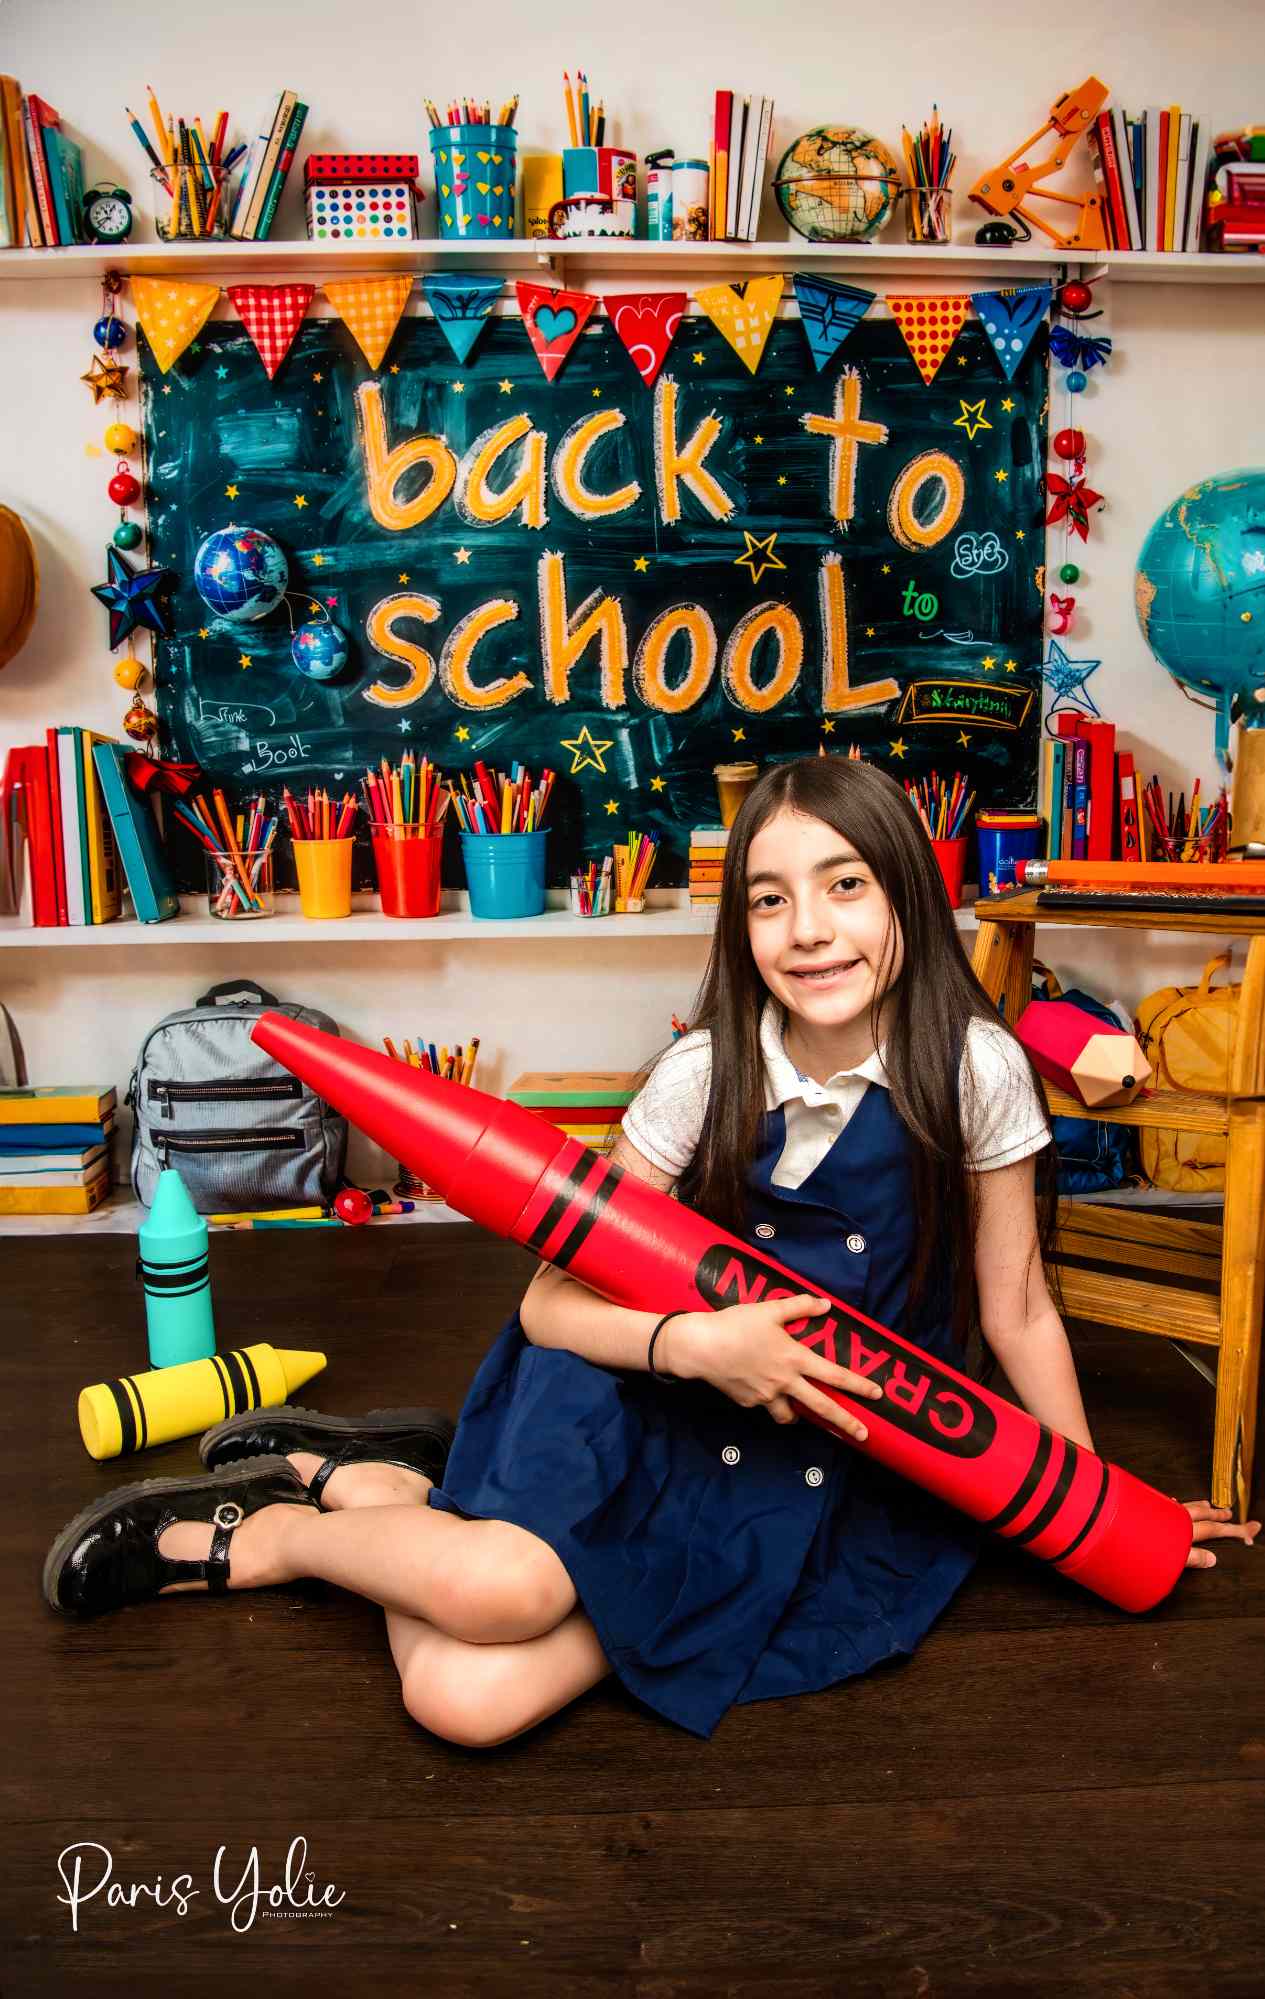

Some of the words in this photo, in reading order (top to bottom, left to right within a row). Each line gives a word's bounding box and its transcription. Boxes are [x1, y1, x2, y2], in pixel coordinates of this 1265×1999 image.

[354, 373, 738, 531] back
[799, 364, 966, 552] to
[901, 580, 939, 621] to
[251, 733, 312, 771] Book
